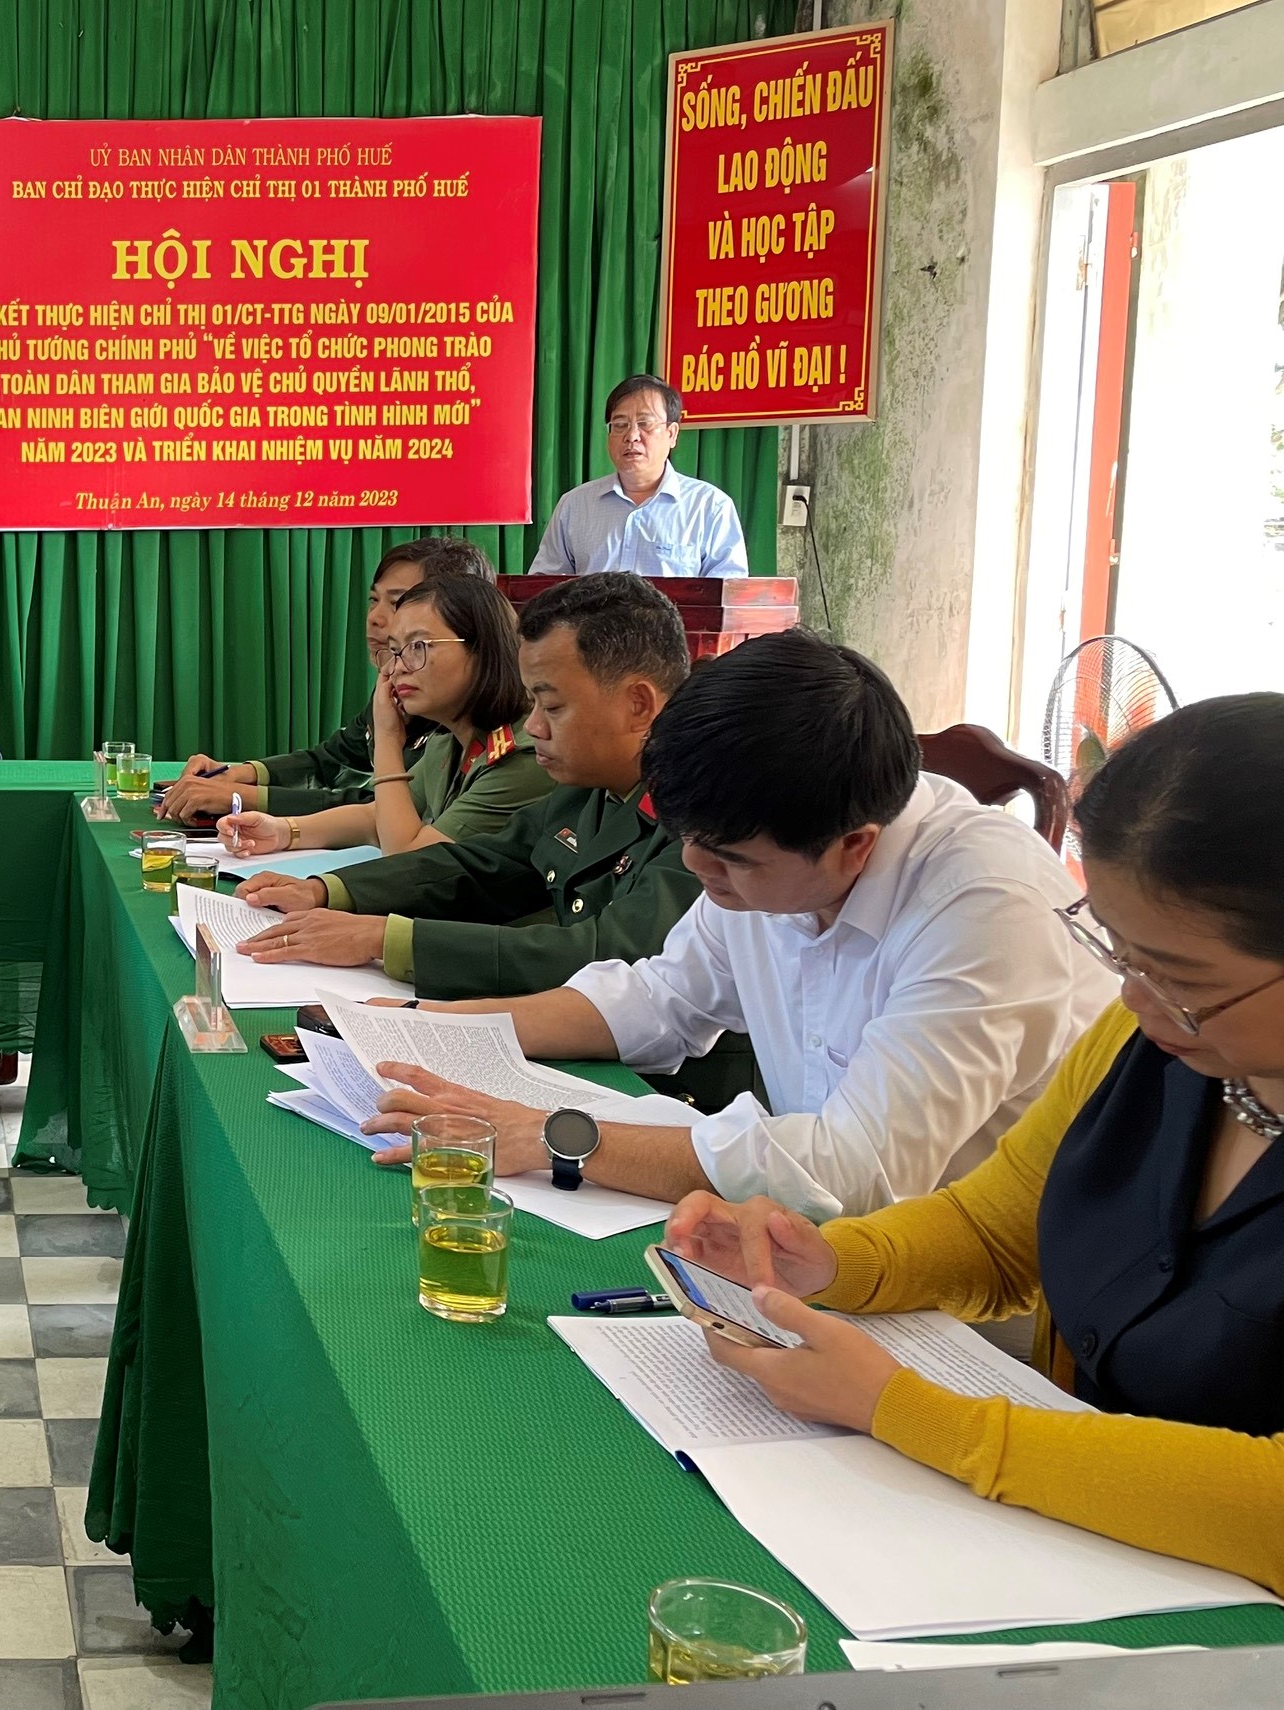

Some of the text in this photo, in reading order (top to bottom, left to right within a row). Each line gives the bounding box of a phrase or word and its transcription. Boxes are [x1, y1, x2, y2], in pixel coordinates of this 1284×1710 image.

[682, 51, 874, 132] SỐNG, CHIẾN ĐẤU
[119, 149, 151, 166] BAN
[159, 145, 204, 166] NHÂN
[212, 145, 246, 165] DÂN
[252, 144, 309, 165] THÀNH
[318, 143, 350, 165] PHỐ
[358, 143, 391, 165] HUẾ
[718, 137, 826, 194] LAO ĐỘNG
[12, 172, 469, 202] BAN CHỈ ĐẠO THỰC HIỆN CHỈ THỊ 01 THÀNH PHỐ HUẾ
[709, 203, 834, 263] VÀ HỌC TẬP
[112, 228, 369, 289] HỘI NGHỊ
[35, 303, 83, 330] THỰC
[90, 300, 134, 330] HIỆN
[140, 297, 171, 325] CHỈ
[177, 304, 206, 330] THỊ
[212, 303, 304, 325] 01/CT-TTG
[310, 299, 360, 324] NGÀY
[367, 302, 470, 324] 09/01/2015
[476, 295, 513, 323] CỦA
[696, 278, 833, 327] THEO GƯƠNG
[26, 335, 89, 360] TƯỚNG
[95, 335, 153, 360] CHÍNH
[159, 332, 196, 359] PHỦ
[242, 335, 283, 363] VIỆC
[289, 330, 312, 358] TỔ
[318, 333, 367, 358] CHỨC
[374, 337, 438, 358] PHONG
[444, 333, 491, 357] TRÀO
[682, 345, 724, 392] BÁC
[731, 336, 760, 390] HỒ
[767, 341, 788, 387] VĨ
[793, 345, 831, 392] ĐẠI
[0, 362, 475, 398] TOÀN DÂN THAM GIA BẢO VỆ CHỦ QUYỀN LÃNH THỔ,
[27, 408, 74, 428] NINH
[80, 404, 124, 428] BIÊN
[130, 403, 167, 429] GIỚI
[174, 399, 223, 430] QUỐC
[230, 406, 261, 427] GIA
[267, 406, 328, 427] TRONG
[334, 401, 376, 426] TÌNH
[383, 401, 427, 425] HÌNH
[21, 432, 453, 465] NĂM 2023 VÀ TRIỂN KHAI NHIỆM VỤ NĂM 2024
[76, 490, 398, 513] Thuận An, ngày 14 tháng 12 năm 2023
